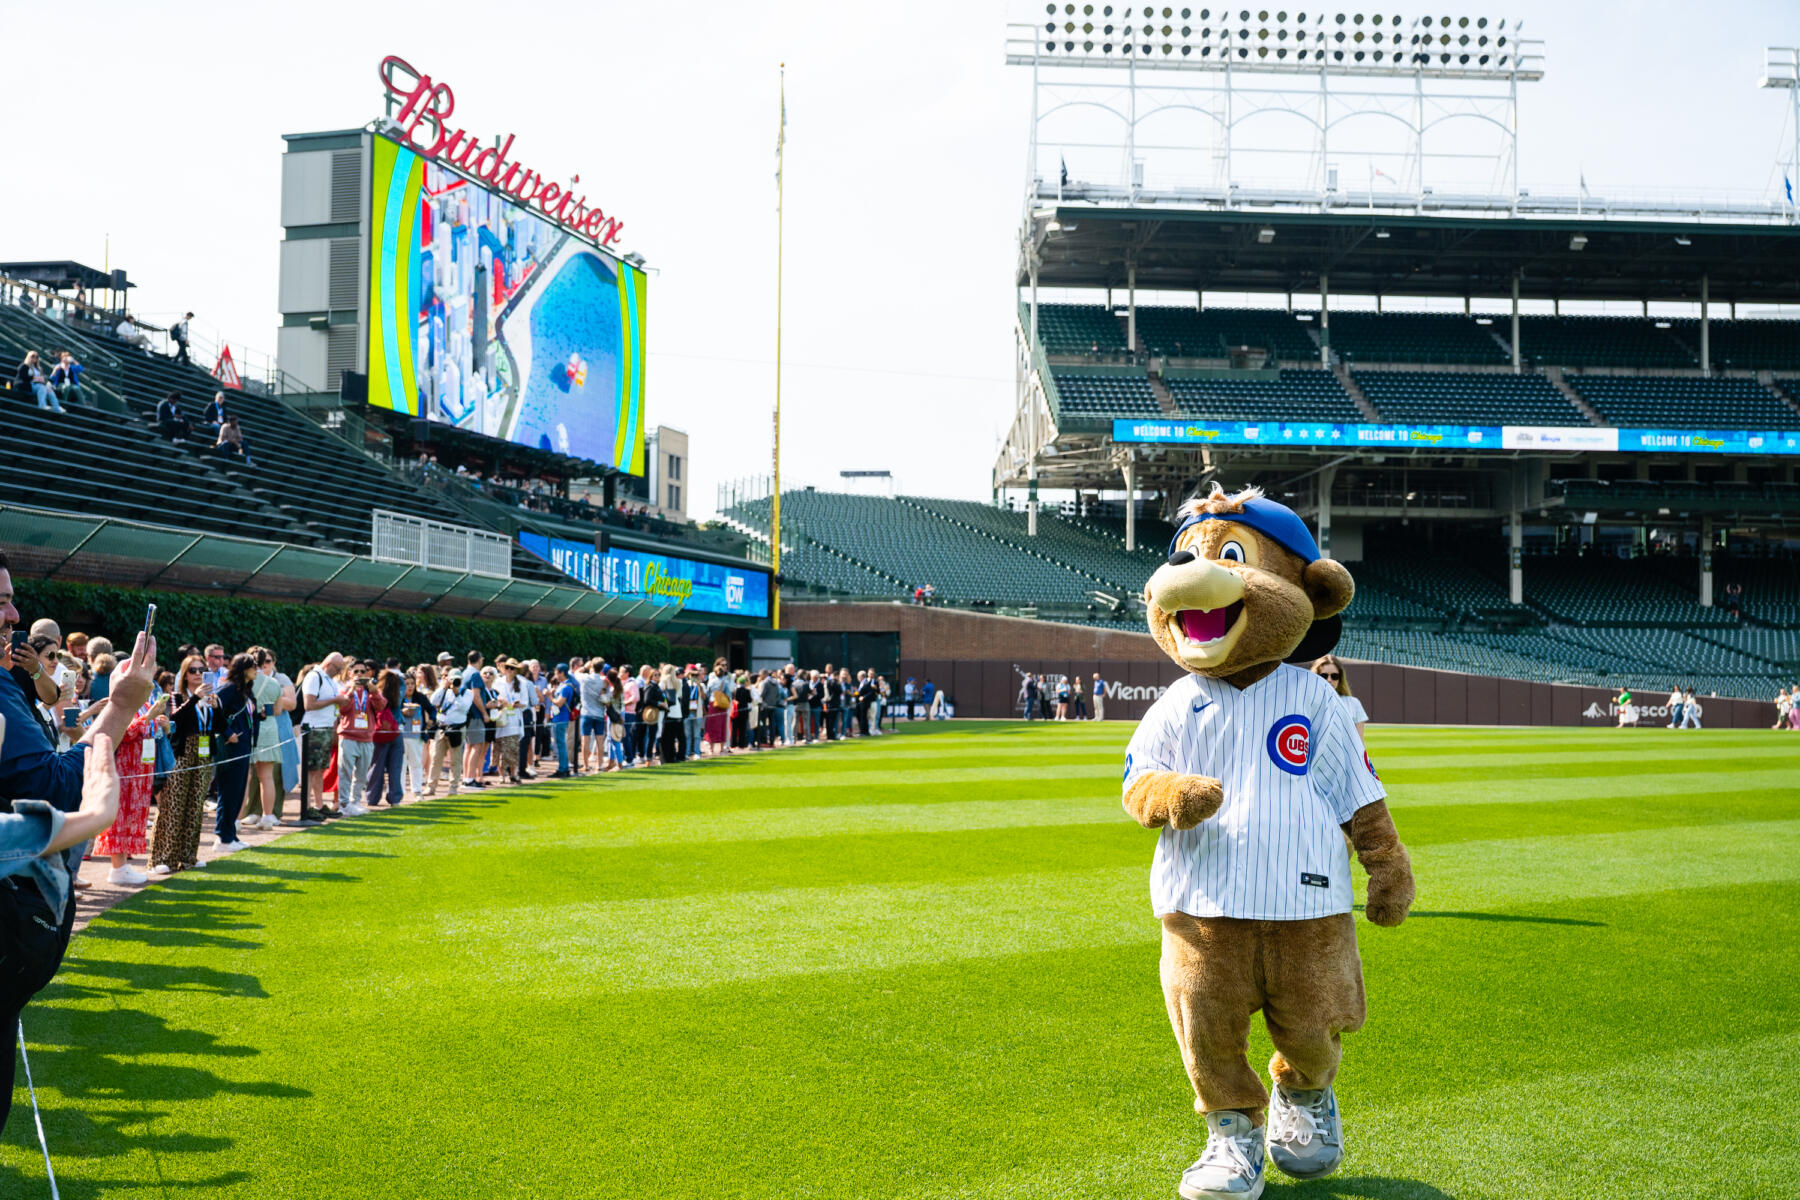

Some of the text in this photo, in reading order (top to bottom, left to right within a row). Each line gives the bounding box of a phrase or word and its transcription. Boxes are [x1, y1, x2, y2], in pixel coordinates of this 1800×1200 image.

[380, 55, 624, 246] Budweiser
[1133, 426, 1219, 440] WELCOME TO Chicago
[1358, 429, 1443, 444] WELCOME TO Chicago
[1641, 435, 1725, 450] WELCOME TO Chicago
[625, 559, 640, 595] TO
[644, 561, 692, 604] Chicago
